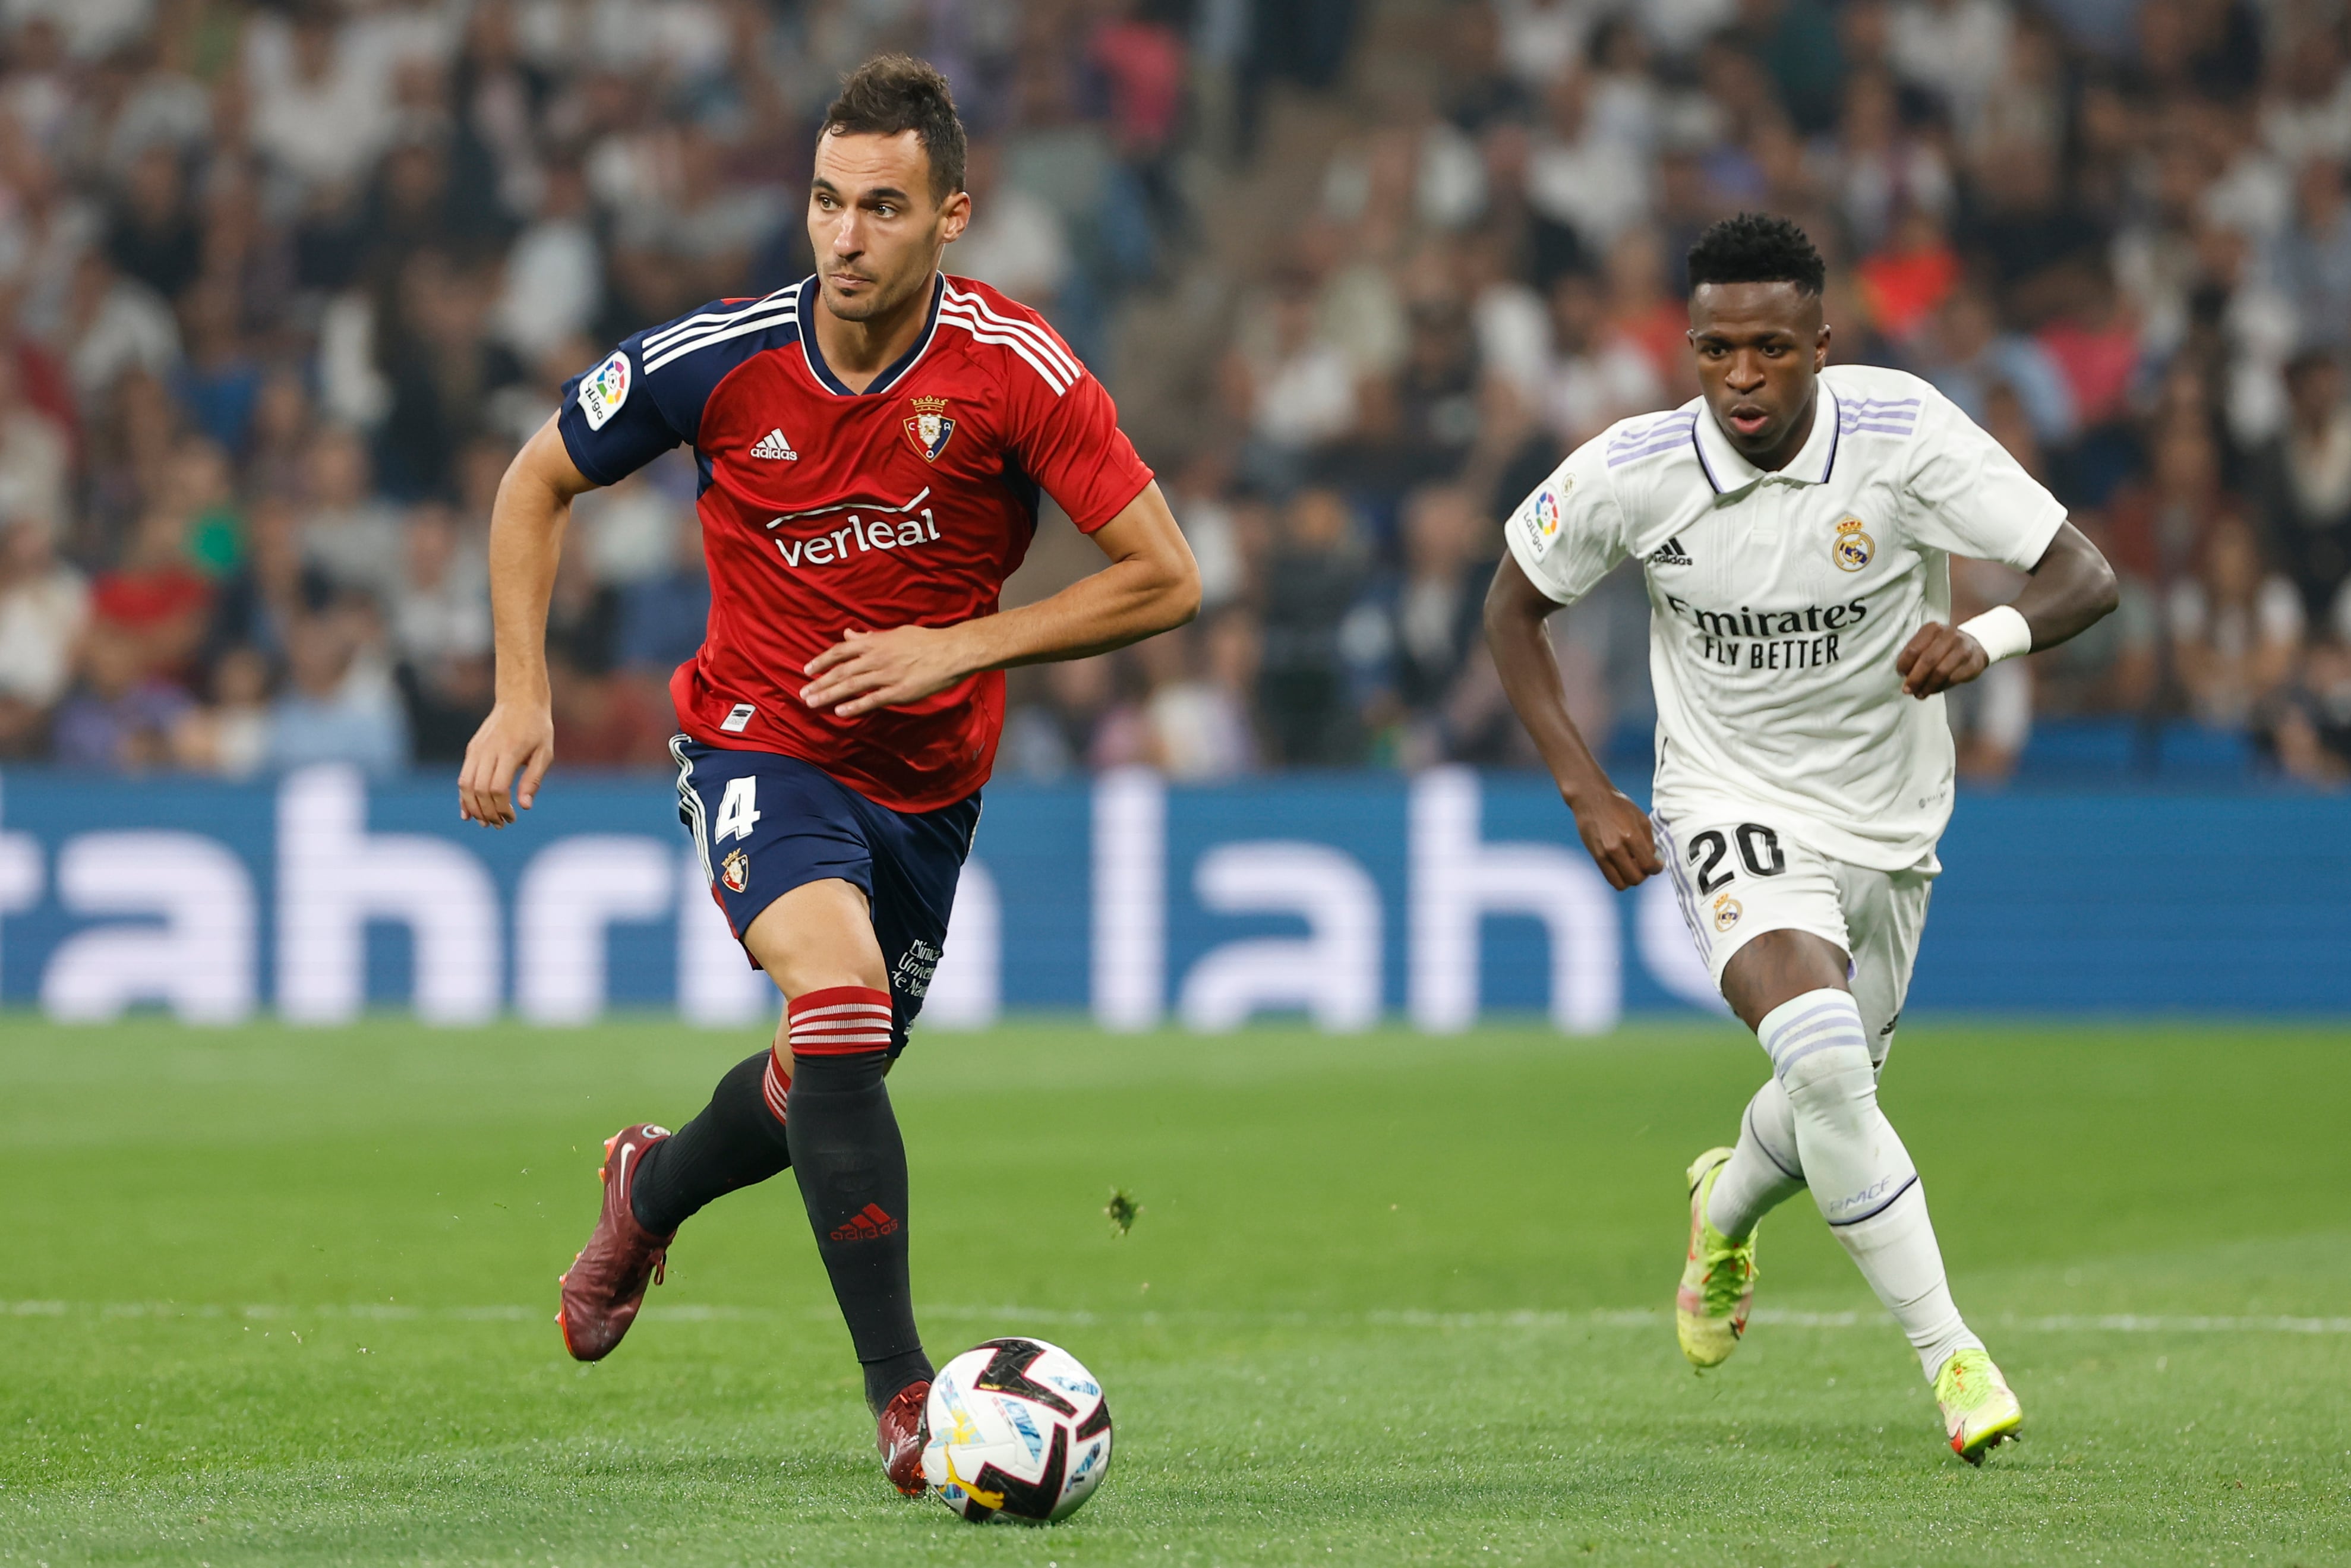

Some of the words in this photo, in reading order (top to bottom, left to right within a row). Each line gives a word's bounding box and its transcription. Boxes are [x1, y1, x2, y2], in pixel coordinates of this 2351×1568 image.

[750, 447, 798, 461] adidas
[775, 508, 941, 567] verleal
[1523, 512, 1544, 553] LaLiga
[1665, 593, 1867, 637] Emirates
[1705, 636, 1740, 666] FLY
[1751, 634, 1839, 670] BETTER
[715, 775, 760, 845] 4
[1687, 823, 1785, 898] 20
[830, 1219, 898, 1241] adidas
